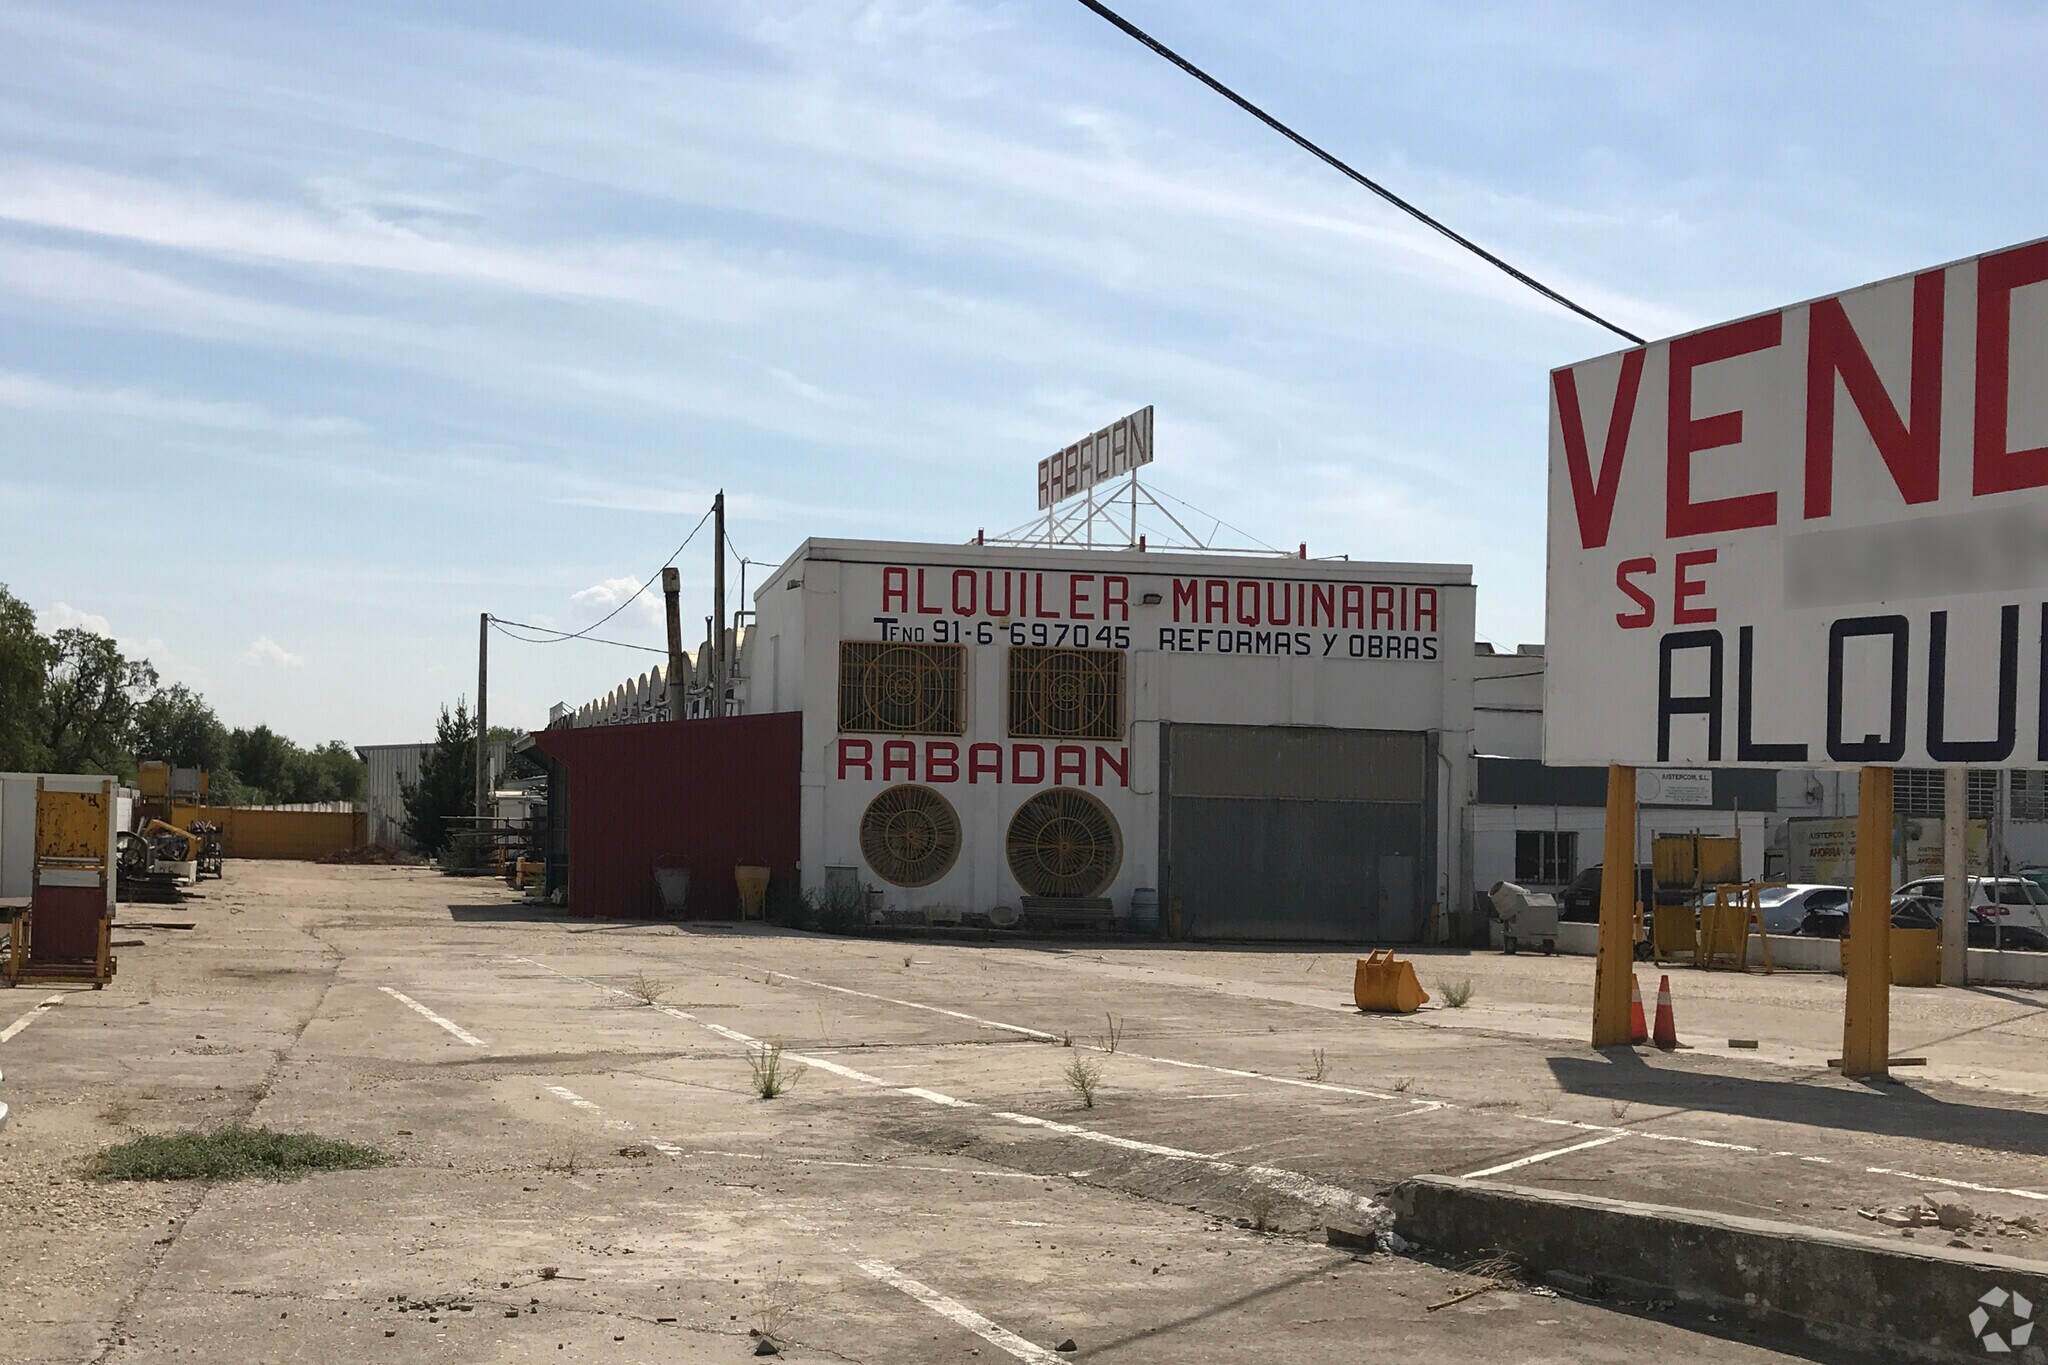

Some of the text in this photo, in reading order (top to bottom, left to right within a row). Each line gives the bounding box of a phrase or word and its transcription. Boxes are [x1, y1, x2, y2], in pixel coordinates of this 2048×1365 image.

[1038, 408, 1147, 508] RABADAN
[883, 567, 1437, 632] ALQUILER MAQUINARIA
[1616, 549, 1717, 629] SE
[1159, 627, 1437, 660] REFORMAS Y OBRAS
[838, 738, 1129, 788] RABADAN
